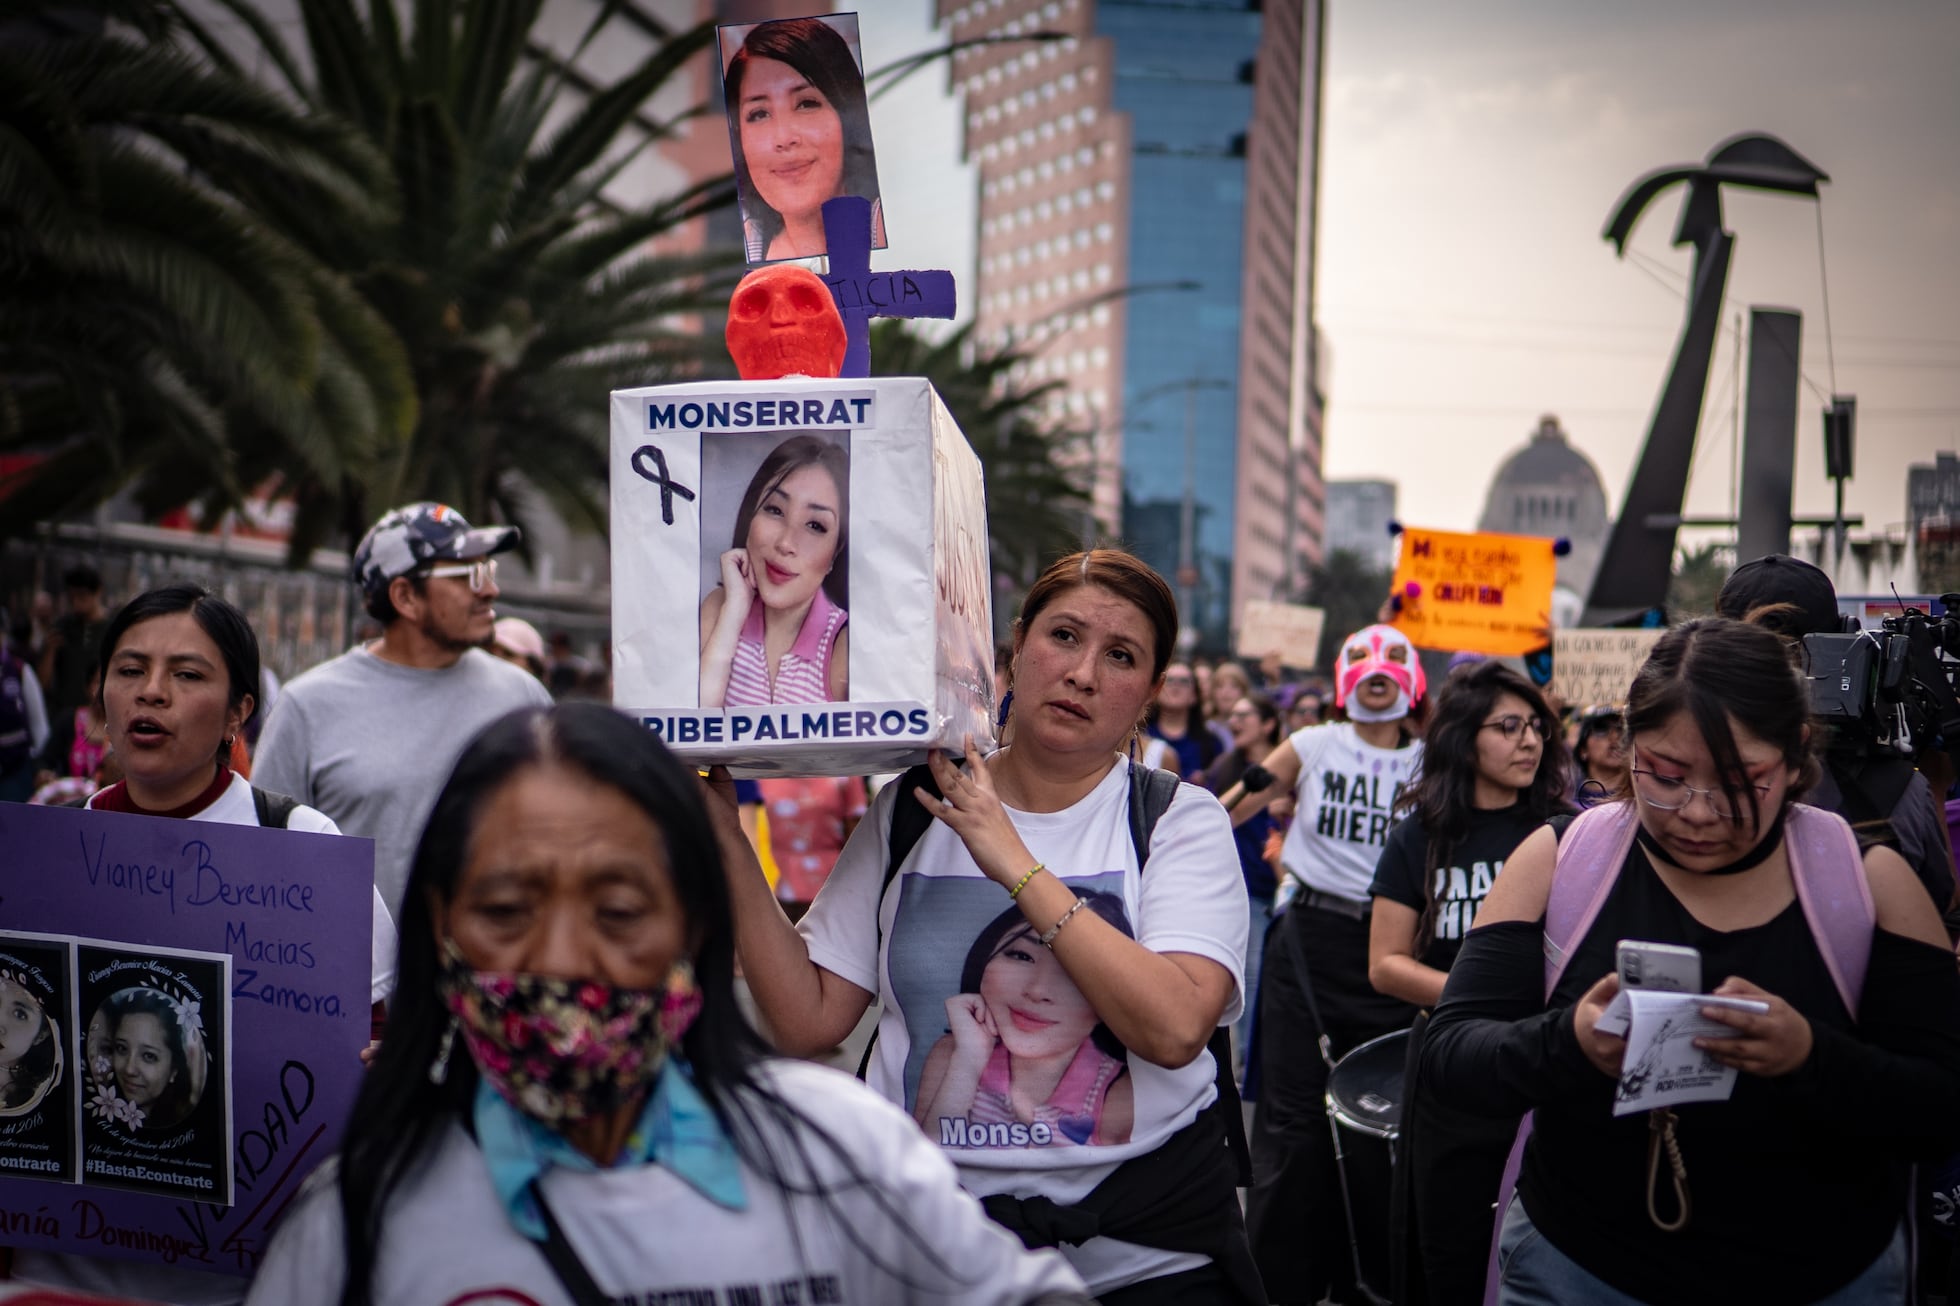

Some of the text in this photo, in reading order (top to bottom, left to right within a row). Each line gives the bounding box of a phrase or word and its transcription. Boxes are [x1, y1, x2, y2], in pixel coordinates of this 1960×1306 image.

[829, 276, 922, 317] TICIA
[649, 398, 872, 429] MONSERRAT
[632, 709, 930, 743] RIBE PALMEROS
[1317, 805, 1387, 847] HIER
[80, 830, 314, 914] Vianey Berenice
[224, 921, 315, 969] Macias
[15, 1111, 44, 1135] 2018
[170, 1128, 195, 1150] 2016
[938, 1116, 1053, 1147] Monse
[176, 1060, 314, 1250] VDAD
[85, 1158, 214, 1190] #HastaEcontrarte
